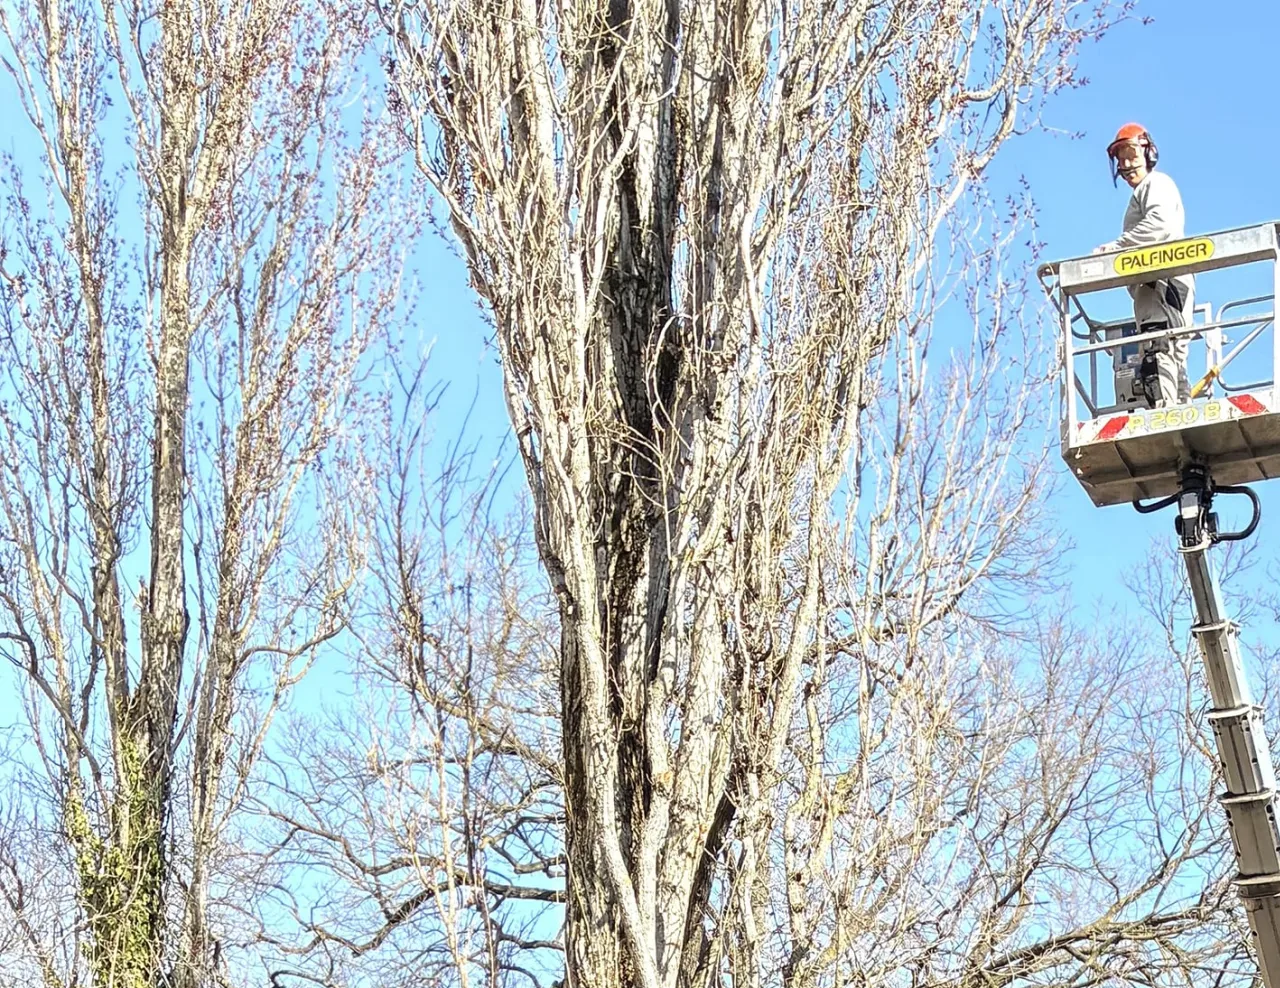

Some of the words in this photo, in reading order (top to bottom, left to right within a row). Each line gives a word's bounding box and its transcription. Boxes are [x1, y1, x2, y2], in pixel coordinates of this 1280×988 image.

[1121, 242, 1208, 271] PALFINGER
[1127, 414, 1145, 435] P
[1150, 405, 1199, 431] 260
[1203, 401, 1221, 421] B
